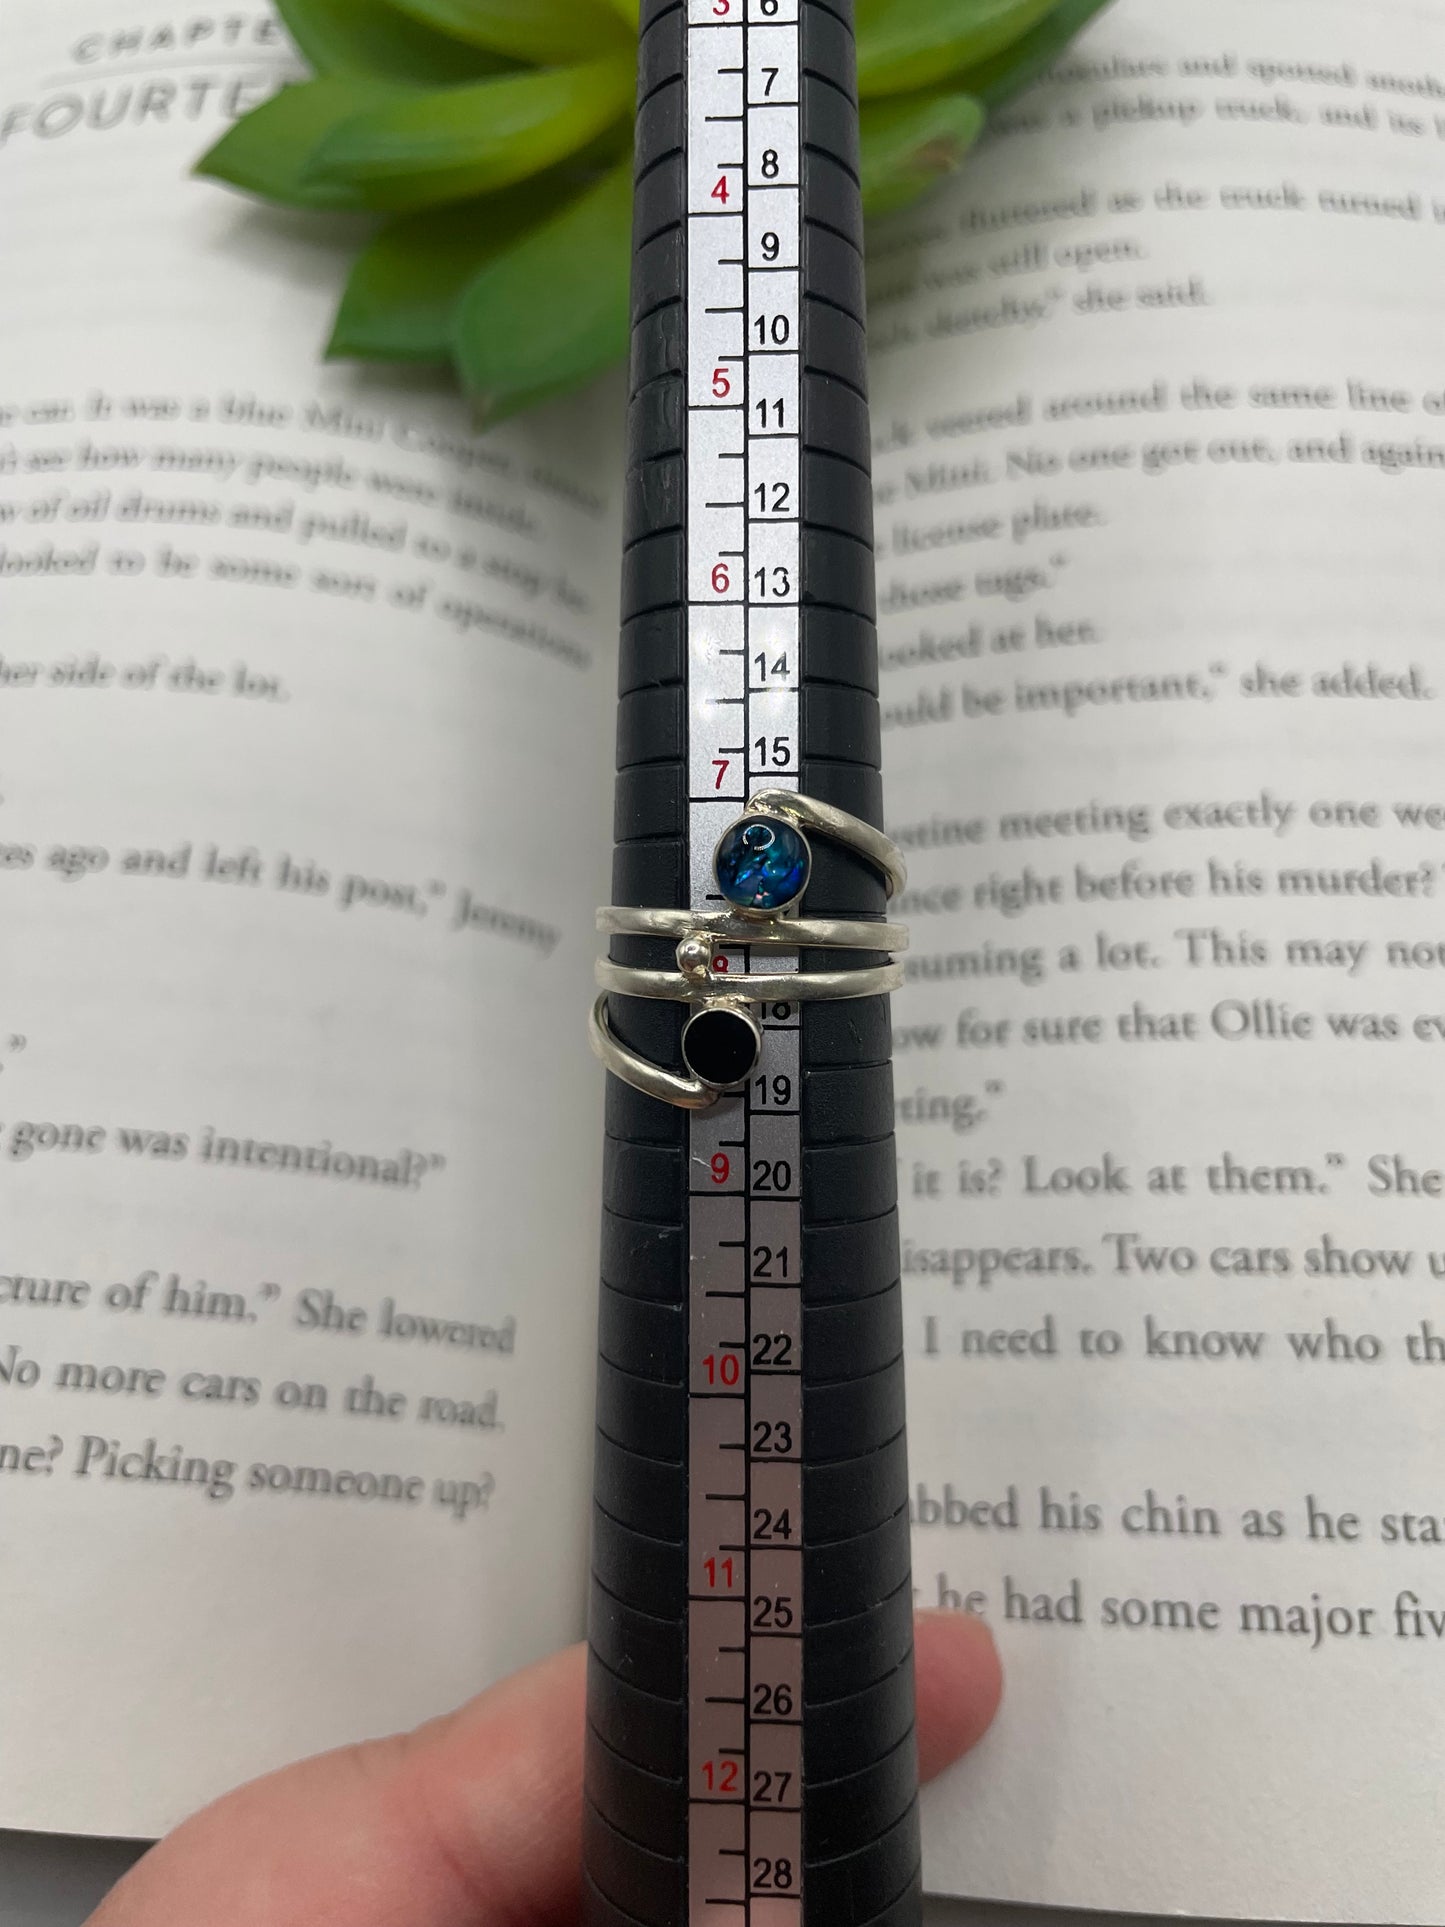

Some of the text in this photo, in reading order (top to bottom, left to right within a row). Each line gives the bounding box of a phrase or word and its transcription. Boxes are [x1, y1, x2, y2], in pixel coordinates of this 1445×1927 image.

[761, 68, 779, 96] 7
[761, 149, 779, 178] 8
[711, 176, 729, 204] 4
[761, 232, 779, 261] 9
[754, 315, 789, 345] 10
[712, 368, 730, 398] 5
[756, 398, 783, 428] 11
[755, 482, 790, 512] 12
[711, 563, 729, 593] 6
[754, 567, 790, 597] 13
[755, 652, 790, 682] 14
[755, 737, 790, 766] 15
[711, 760, 729, 789] 7
[1308, 799, 1378, 831] one
[1076, 857, 1193, 902] before
[1208, 855, 1264, 897] his
[1174, 925, 1267, 968] This
[1285, 937, 1369, 978] may
[1021, 1014, 1102, 1046] sure
[1116, 1000, 1199, 1043] that
[1210, 998, 1314, 1043] Ollie
[1326, 1010, 1400, 1041] was
[755, 1075, 791, 1105] 19
[10, 1120, 105, 1163] gone
[118, 1125, 188, 1161] was
[711, 1152, 729, 1183] 9
[753, 1160, 791, 1191] 20
[1023, 1151, 1131, 1197] Look
[1147, 1161, 1188, 1195] at
[1367, 1151, 1445, 1198] She
[753, 1246, 788, 1277] 21
[902, 1230, 1410, 1292] isappears. Two cars show
[107, 1267, 159, 1312] of
[294, 1287, 367, 1333] She
[379, 1297, 517, 1357] lowered
[753, 1334, 791, 1365] 22
[961, 1313, 1058, 1359] need
[1080, 1324, 1122, 1357] to
[1144, 1313, 1265, 1360] know
[1287, 1316, 1383, 1364] who
[703, 1354, 739, 1385] 10
[56, 1359, 166, 1396] more
[179, 1368, 261, 1406] cars
[274, 1379, 328, 1411] on
[343, 1374, 406, 1420] the
[753, 1421, 792, 1453] 23
[74, 1433, 237, 1502] Picking
[248, 1461, 426, 1505] someone
[431, 1470, 496, 1522] up?
[753, 1509, 791, 1540] 24
[1039, 1485, 1103, 1533] his
[1121, 1488, 1222, 1538] chin
[1241, 1506, 1285, 1540] as
[1305, 1493, 1361, 1542] he
[1381, 1510, 1445, 1547] sta
[703, 1557, 733, 1588] 11
[753, 1595, 792, 1628] 25
[1003, 1574, 1085, 1624] had
[1101, 1594, 1221, 1630] some
[1240, 1592, 1376, 1650] major
[753, 1684, 792, 1715] 26
[702, 1761, 738, 1791] 12
[753, 1771, 791, 1802] 27
[753, 1857, 792, 1888] 28
